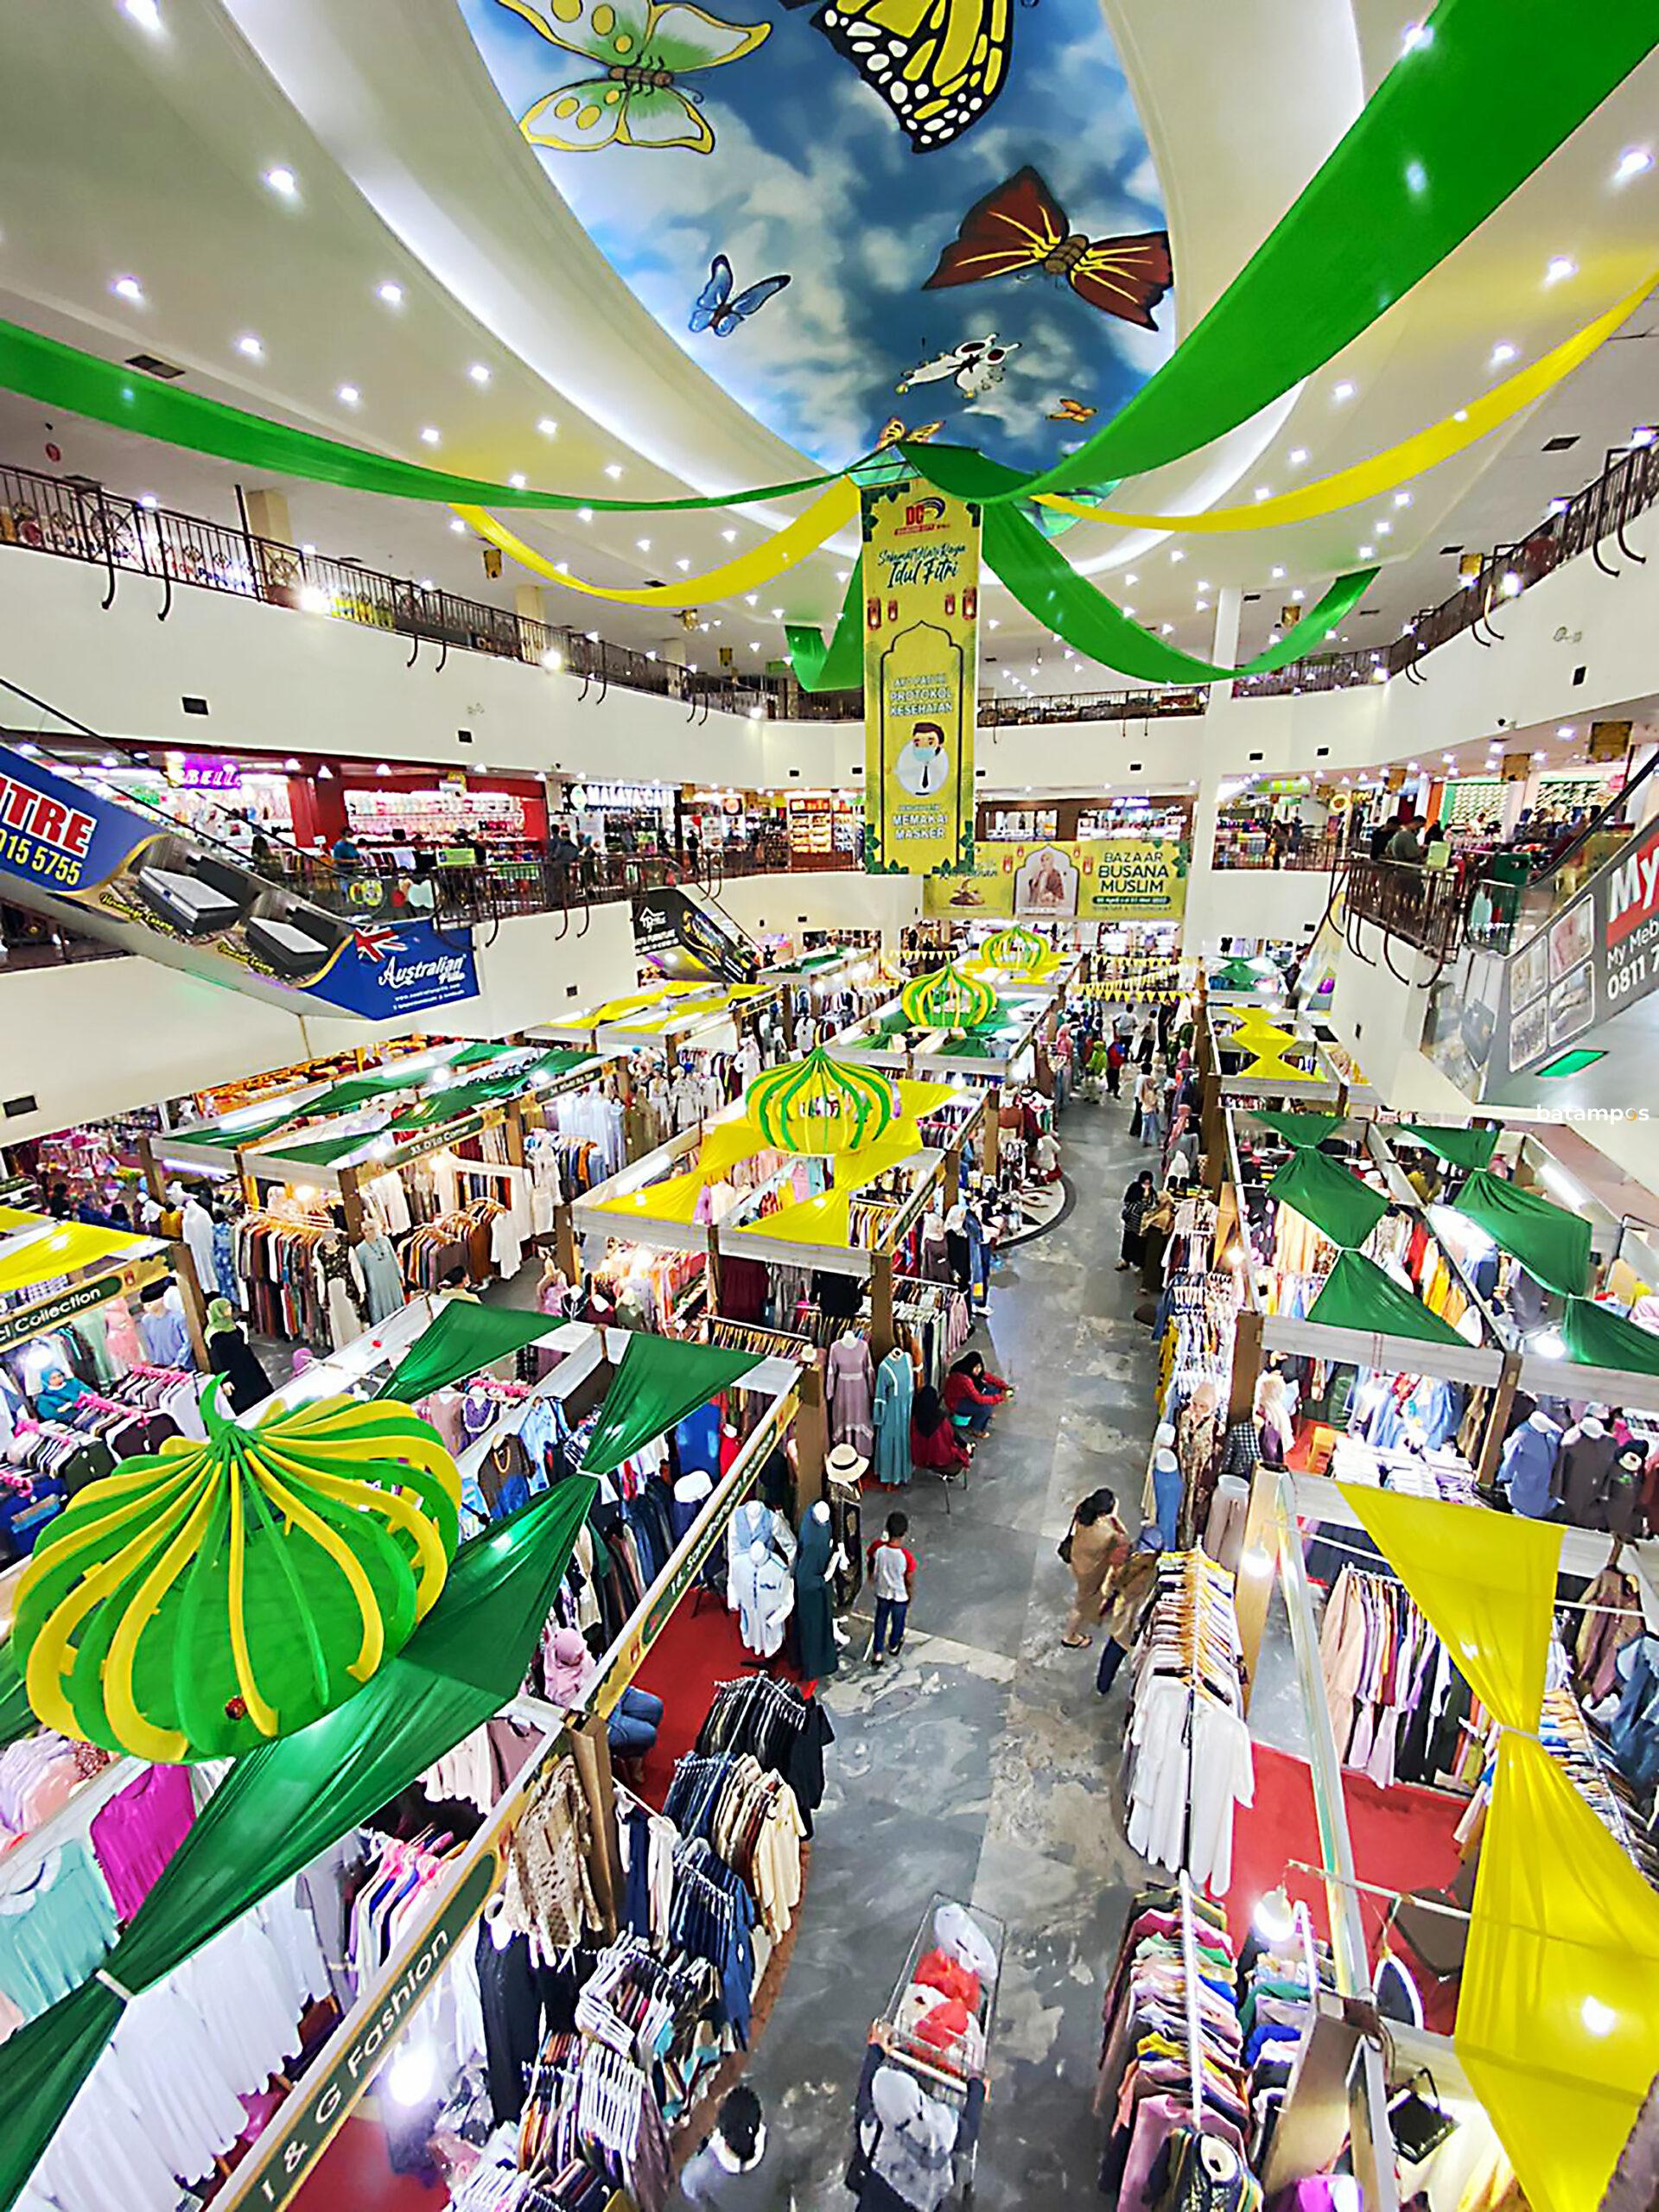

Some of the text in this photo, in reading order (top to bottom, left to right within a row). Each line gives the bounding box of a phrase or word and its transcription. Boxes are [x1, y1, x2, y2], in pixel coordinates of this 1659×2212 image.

[887, 557, 959, 588] Idul Fitri
[890, 688, 951, 702] PROTOKOL
[890, 702, 952, 716] KESEHATAN
[895, 827, 946, 841] MASKER
[31, 843, 84, 886] 5755
[1104, 851, 1164, 863] BAZAAR
[1098, 864, 1169, 879] BUSANA
[1100, 879, 1164, 893] MUSLIM
[1607, 944, 1627, 970] My
[378, 953, 467, 989] Australian
[1607, 954, 1646, 1001] 0811
[14, 1287, 101, 1333] Collection
[283, 2140, 309, 2174] &
[315, 2085, 343, 2125] G
[347, 1929, 449, 2079] Fashion
